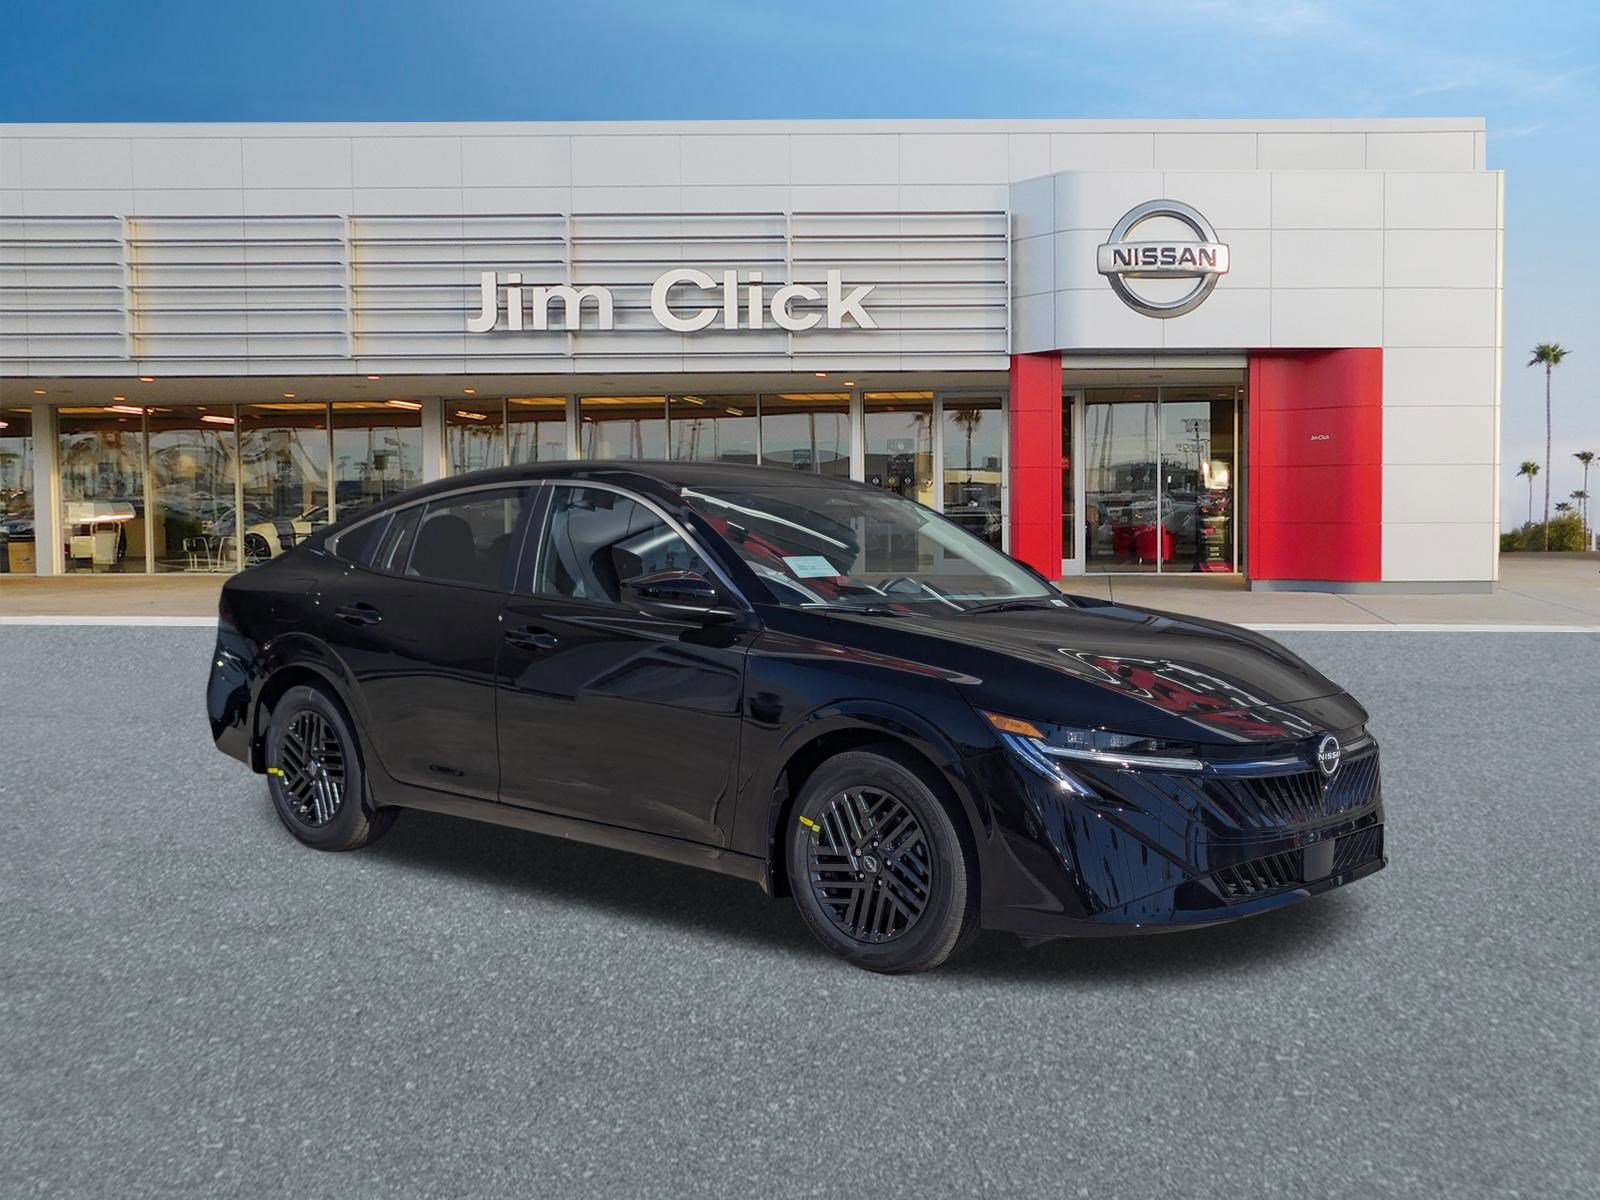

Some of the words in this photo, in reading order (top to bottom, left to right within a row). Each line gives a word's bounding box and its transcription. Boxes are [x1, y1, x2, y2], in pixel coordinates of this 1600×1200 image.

[1113, 247, 1216, 267] NISSAN
[467, 271, 615, 333] Jim
[650, 268, 880, 333] Click
